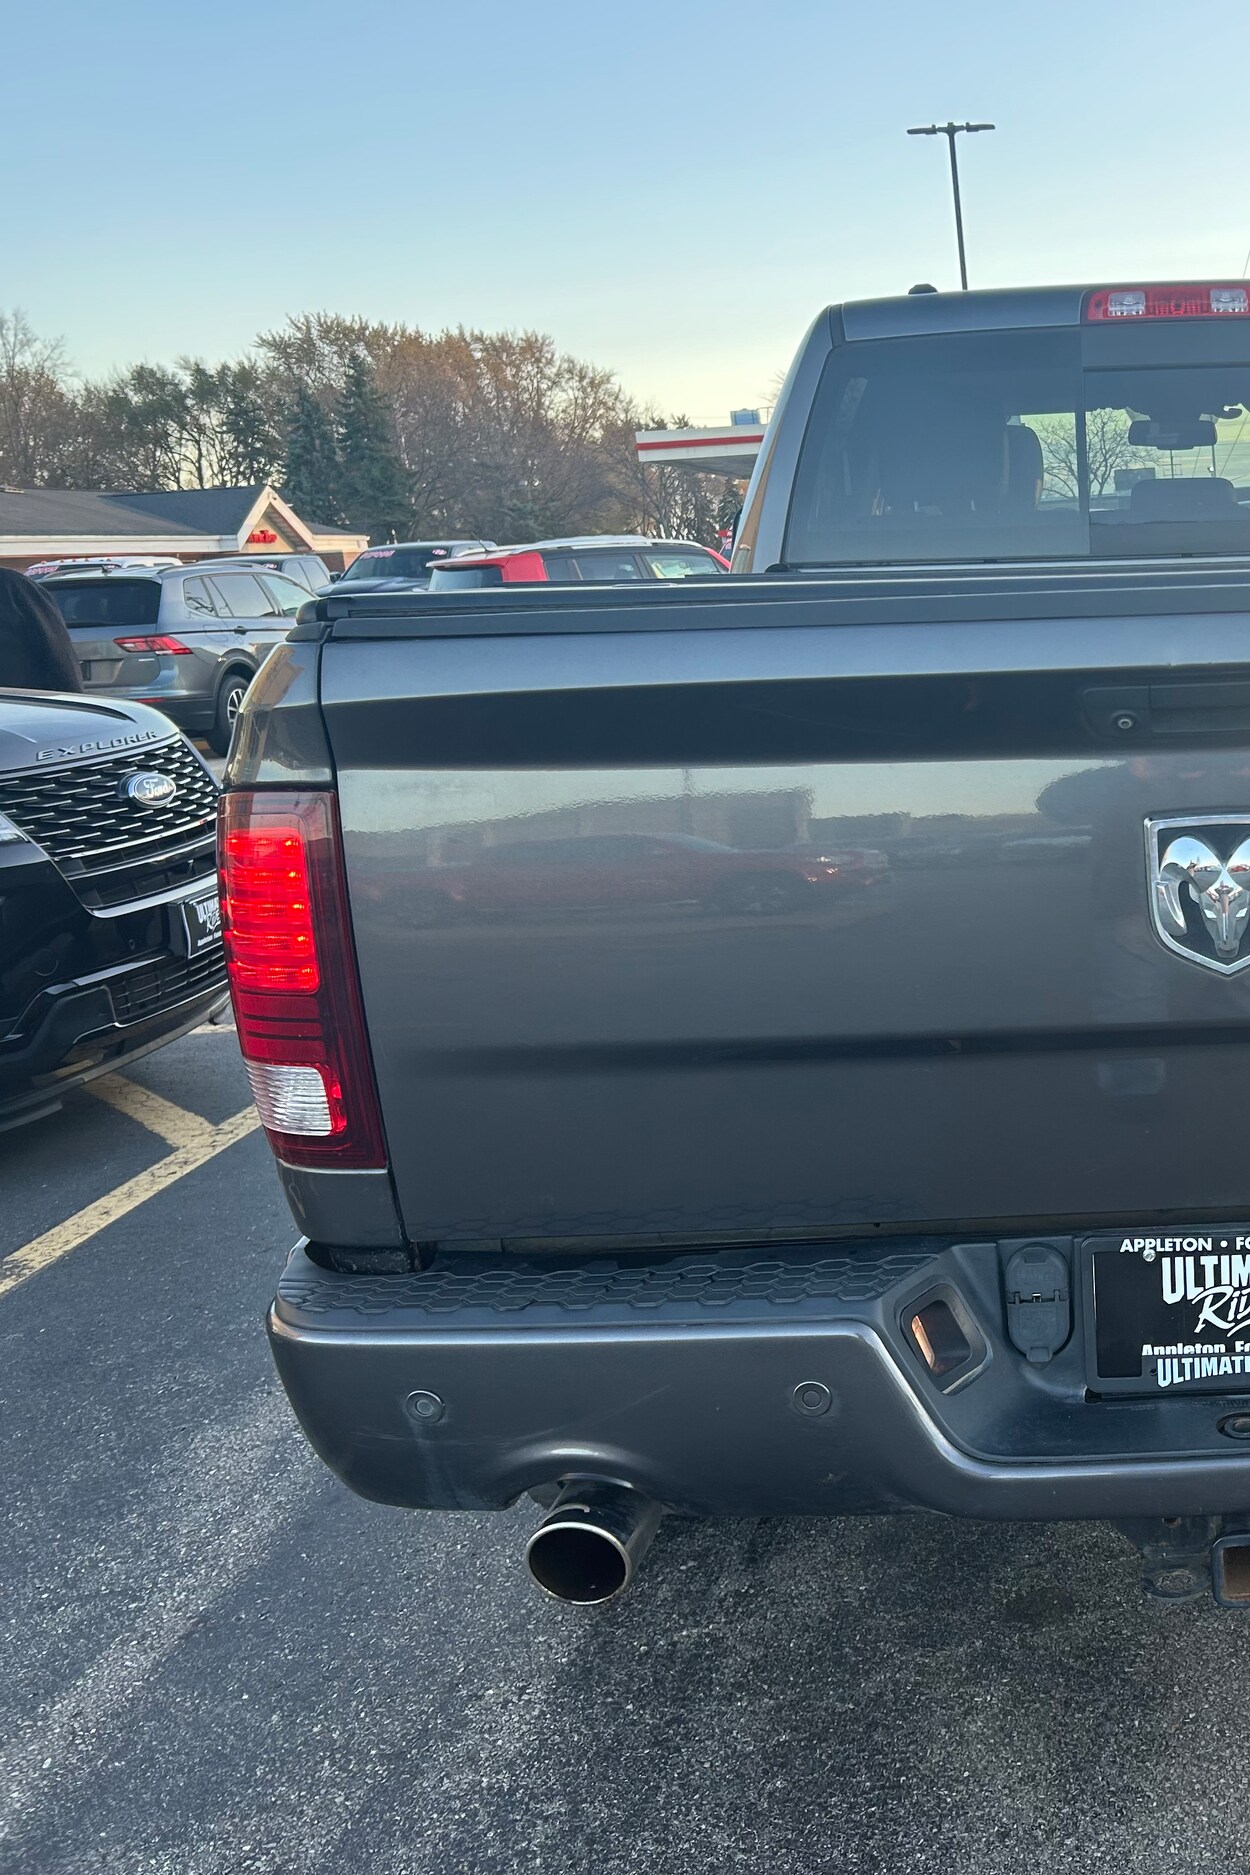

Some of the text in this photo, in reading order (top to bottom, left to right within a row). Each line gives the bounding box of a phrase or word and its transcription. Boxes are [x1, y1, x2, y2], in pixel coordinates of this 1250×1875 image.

[36, 731, 157, 761] EXPLORER
[142, 778, 173, 799] Ford
[1120, 1236, 1213, 1253] APPLETON
